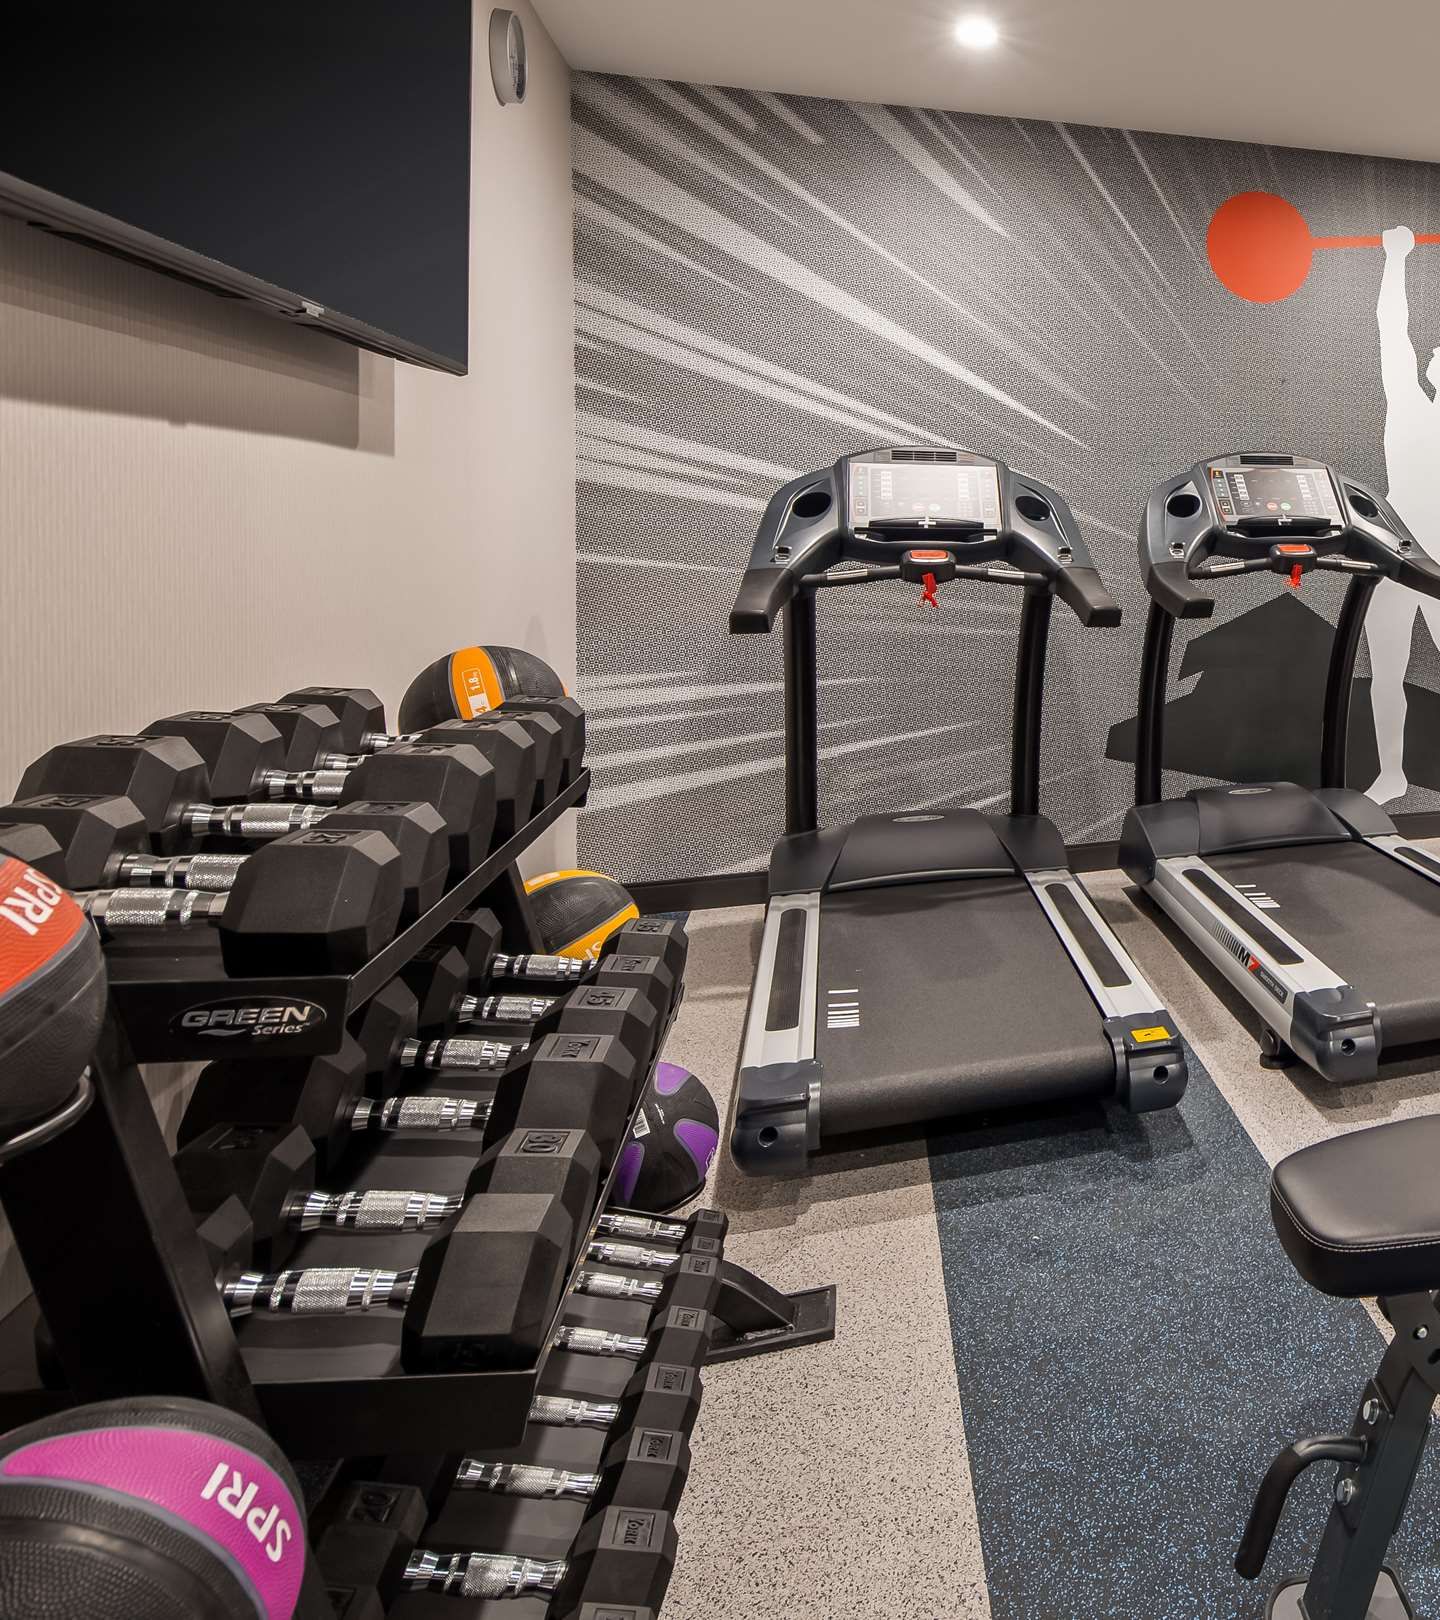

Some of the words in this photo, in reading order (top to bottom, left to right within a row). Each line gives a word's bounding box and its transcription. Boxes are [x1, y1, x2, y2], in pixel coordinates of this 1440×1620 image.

[0, 866, 62, 936] SPRI
[1237, 945, 1261, 972] M7
[181, 1005, 311, 1028] GREEN
[251, 1023, 304, 1036] Series
[200, 1461, 292, 1563] SPRI
